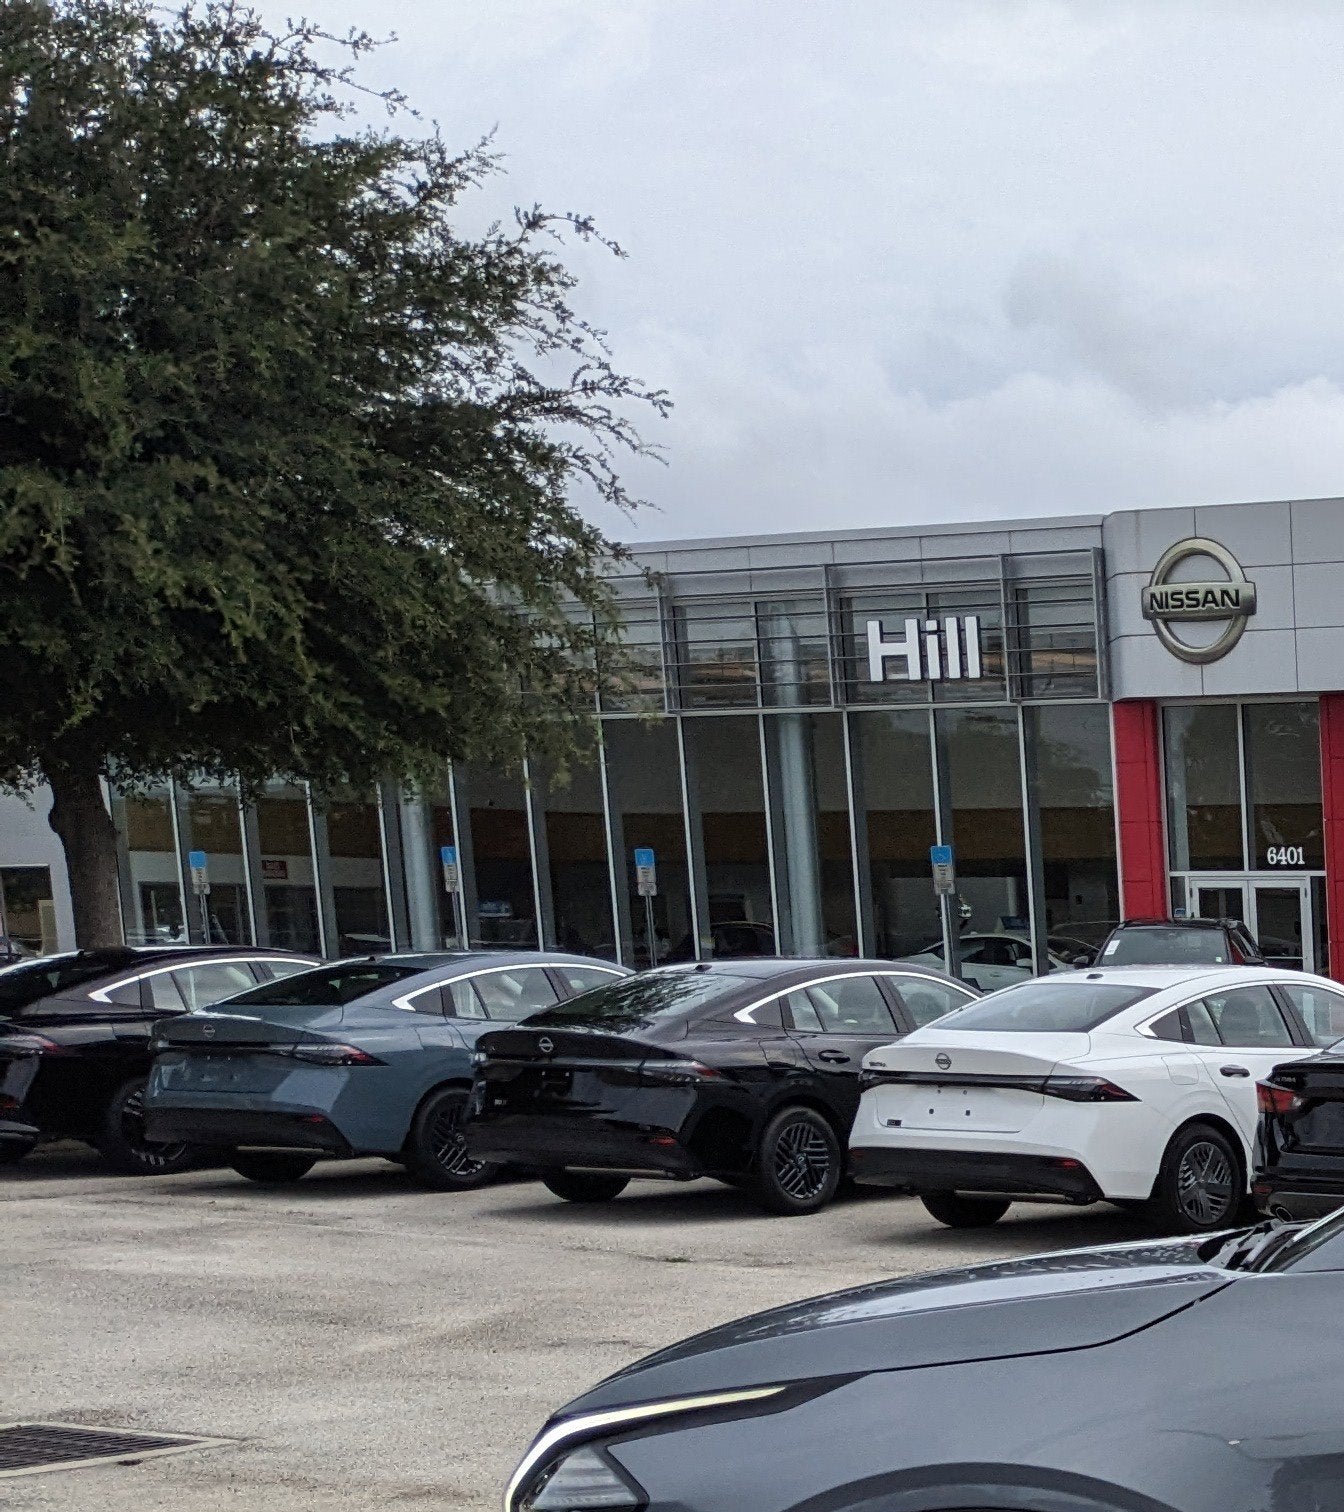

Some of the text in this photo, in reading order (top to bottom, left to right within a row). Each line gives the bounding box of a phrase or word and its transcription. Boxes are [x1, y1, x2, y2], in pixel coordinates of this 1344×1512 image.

[1149, 589, 1240, 611] NISSAN
[866, 616, 981, 682] Hill
[1267, 846, 1305, 865] 6401
